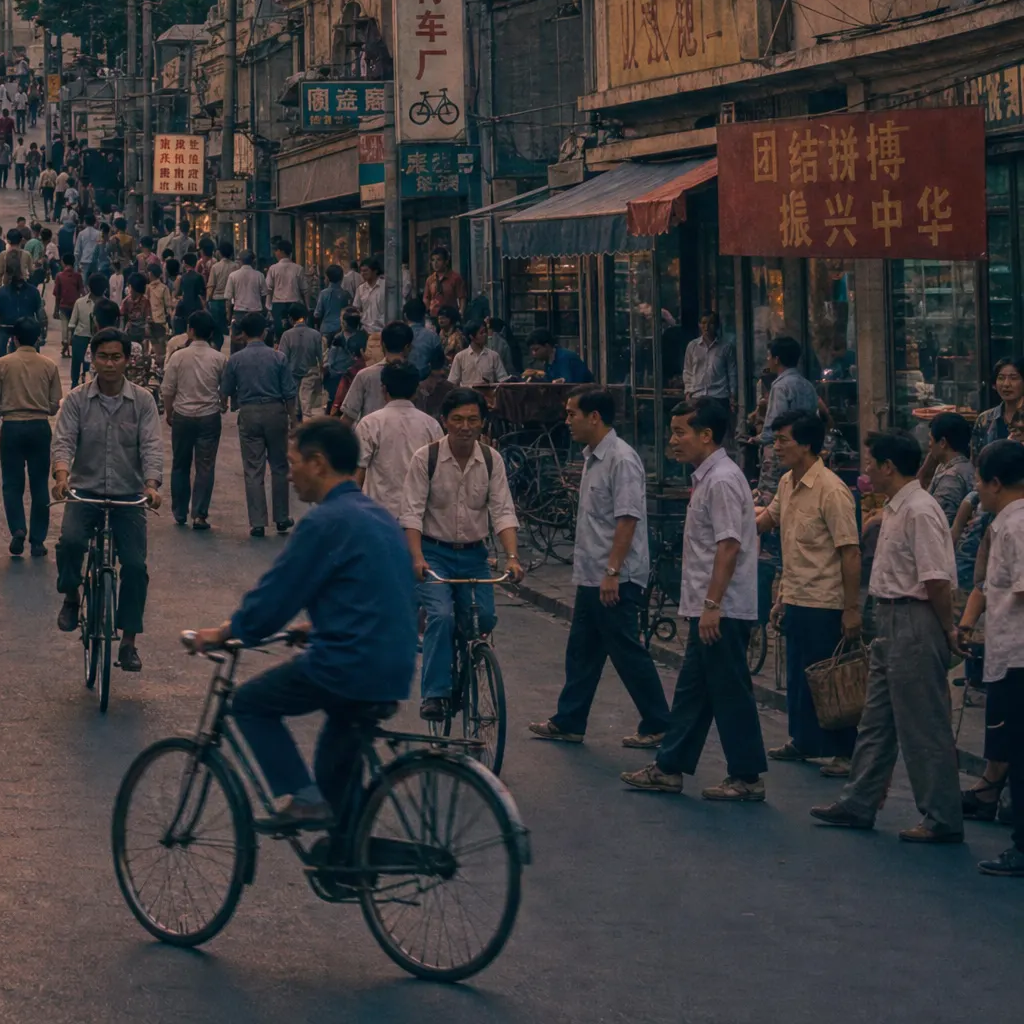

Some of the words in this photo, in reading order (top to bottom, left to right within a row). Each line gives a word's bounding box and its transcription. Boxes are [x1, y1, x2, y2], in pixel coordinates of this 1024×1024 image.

[753, 120, 909, 183] 团结拼搏
[779, 186, 953, 248] 振兴中华
